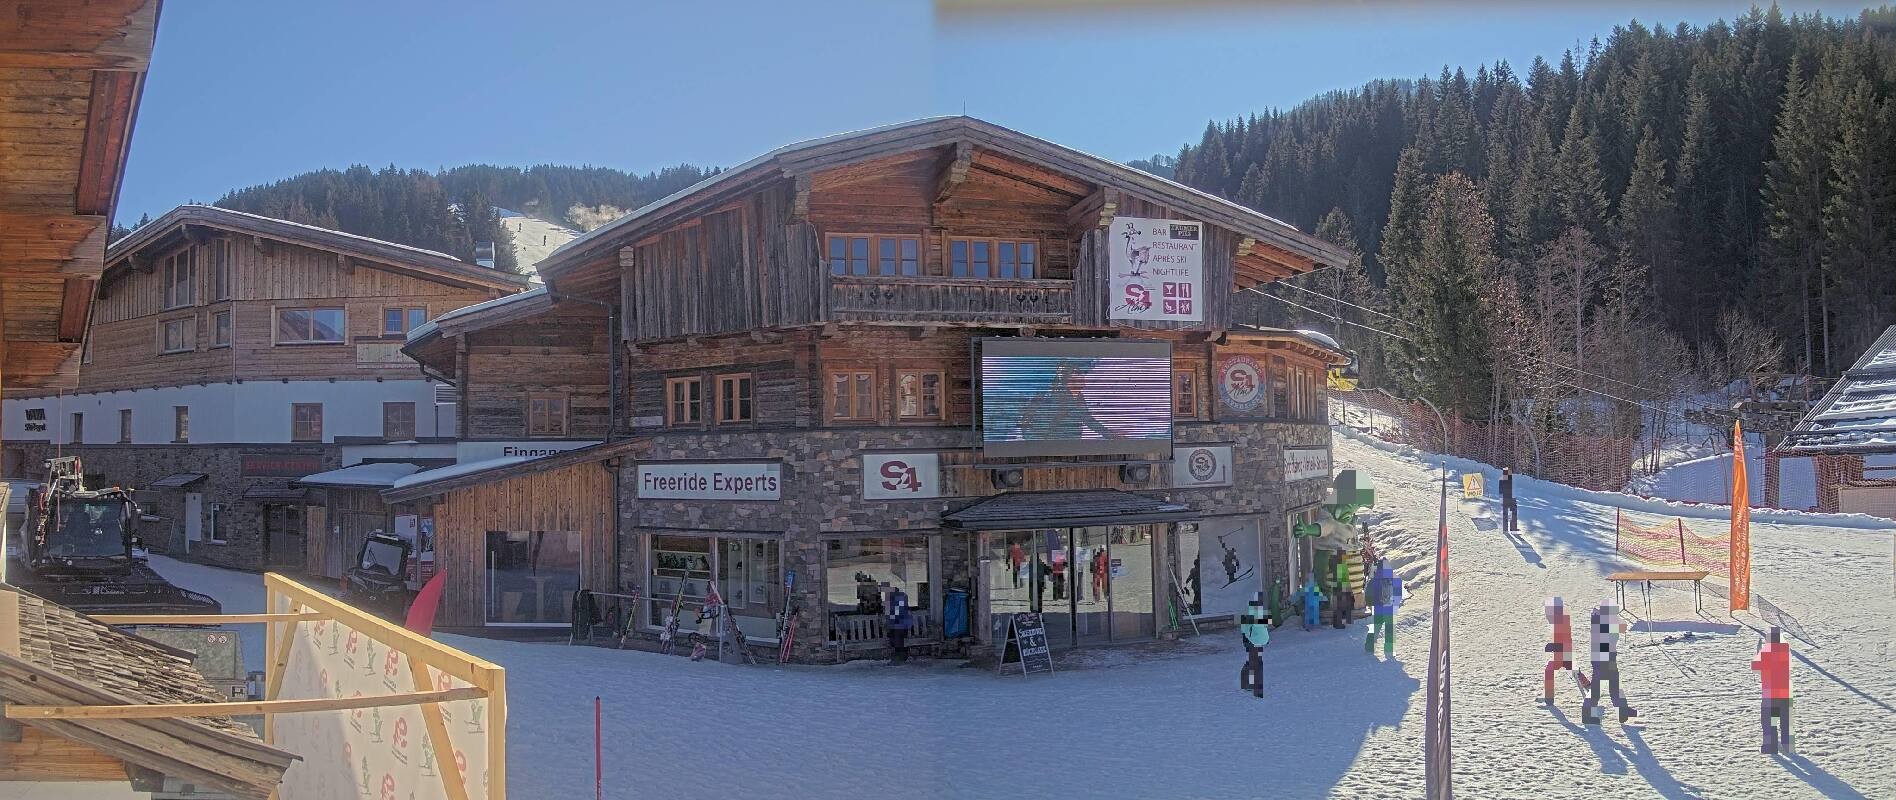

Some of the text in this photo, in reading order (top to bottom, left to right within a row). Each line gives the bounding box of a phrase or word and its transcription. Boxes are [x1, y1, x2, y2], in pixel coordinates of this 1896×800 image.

[1152, 227, 1167, 236] BAR
[1152, 241, 1198, 251] RESTAURANT
[1176, 255, 1187, 264] SKI
[1152, 268, 1189, 277] NIGHTLIFE
[503, 446, 562, 457] Eingan
[880, 460, 922, 492] S4
[644, 472, 777, 494] Freeride Experts
